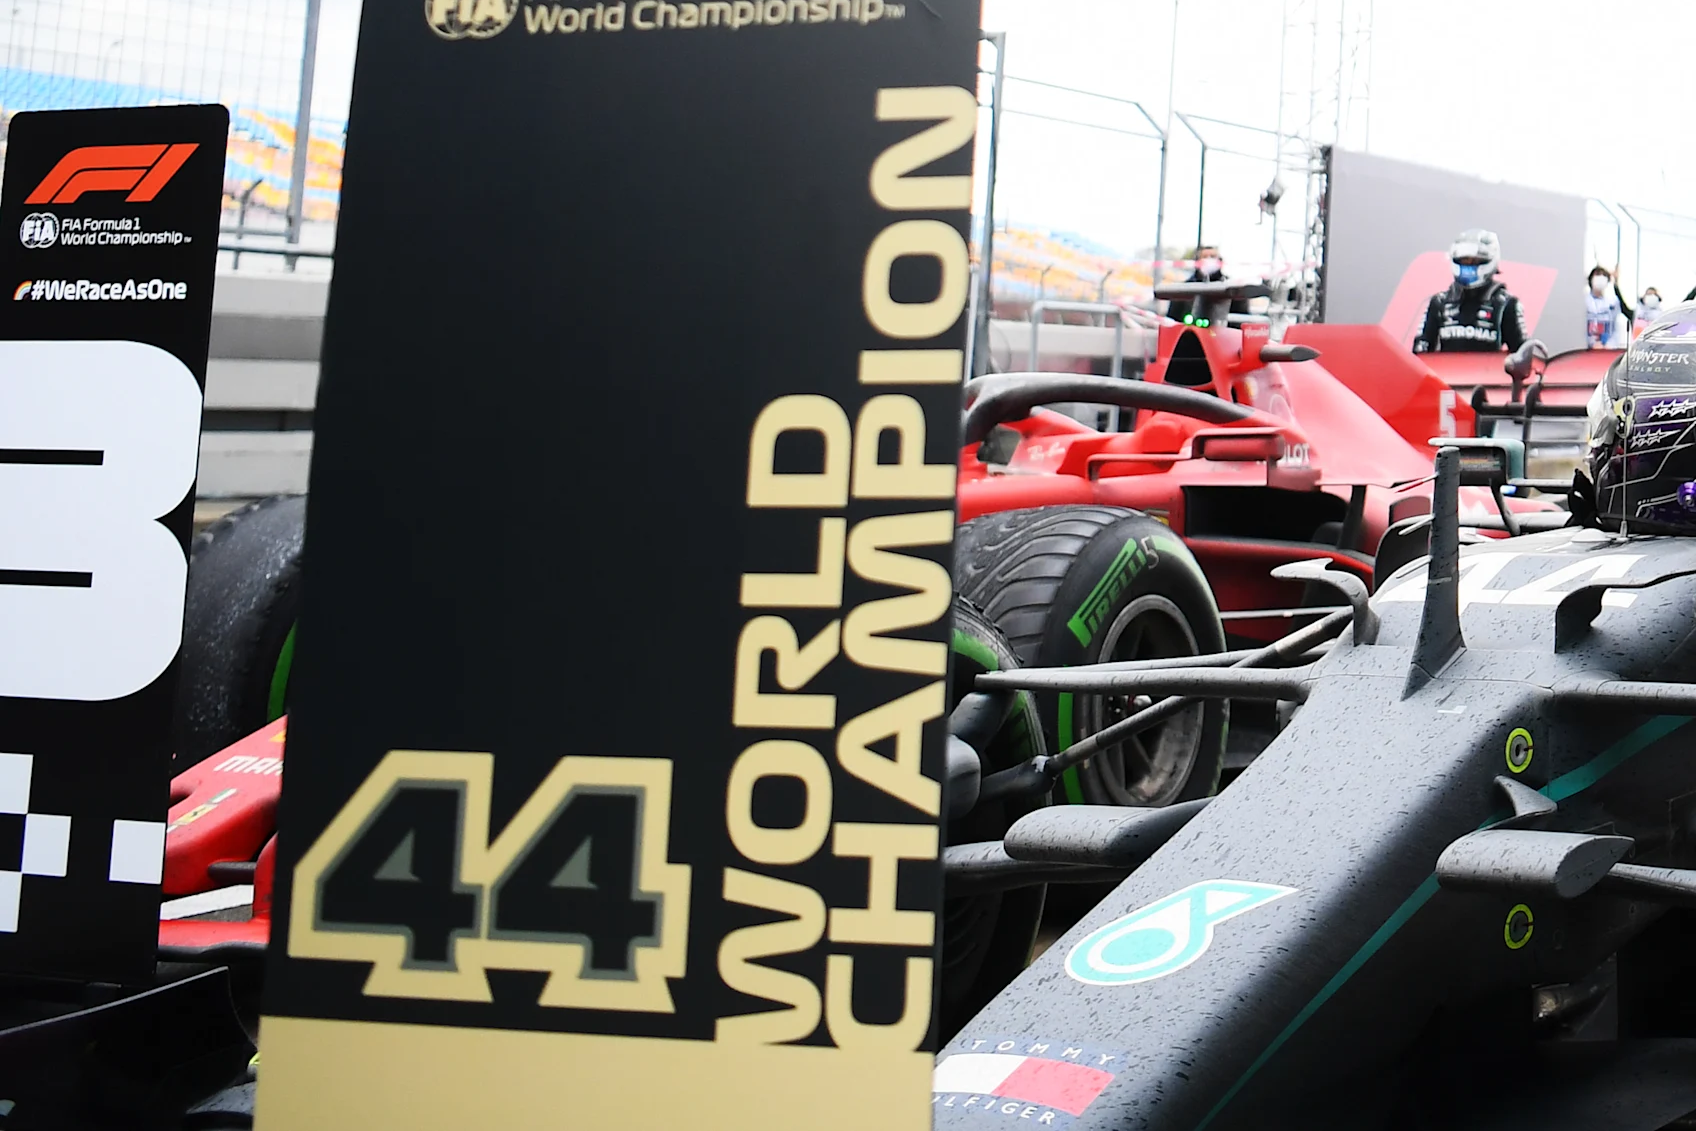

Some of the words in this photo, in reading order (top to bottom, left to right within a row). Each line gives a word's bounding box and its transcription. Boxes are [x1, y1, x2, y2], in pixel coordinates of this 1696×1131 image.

[524, 0, 627, 34] World
[61, 218, 82, 232] FIA
[83, 217, 133, 231] Formula
[133, 216, 141, 229] 1
[61, 231, 96, 246] World
[30, 278, 188, 301] #WeRaceAsOne
[1439, 389, 1458, 438] 5
[825, 85, 979, 1052] CHAMPION
[1066, 537, 1148, 648] PIRELLI
[715, 393, 852, 1044] WORLD
[286, 748, 693, 1014] 44
[970, 1039, 1116, 1066] TOMMY
[931, 1095, 1057, 1126] ILFIGER
